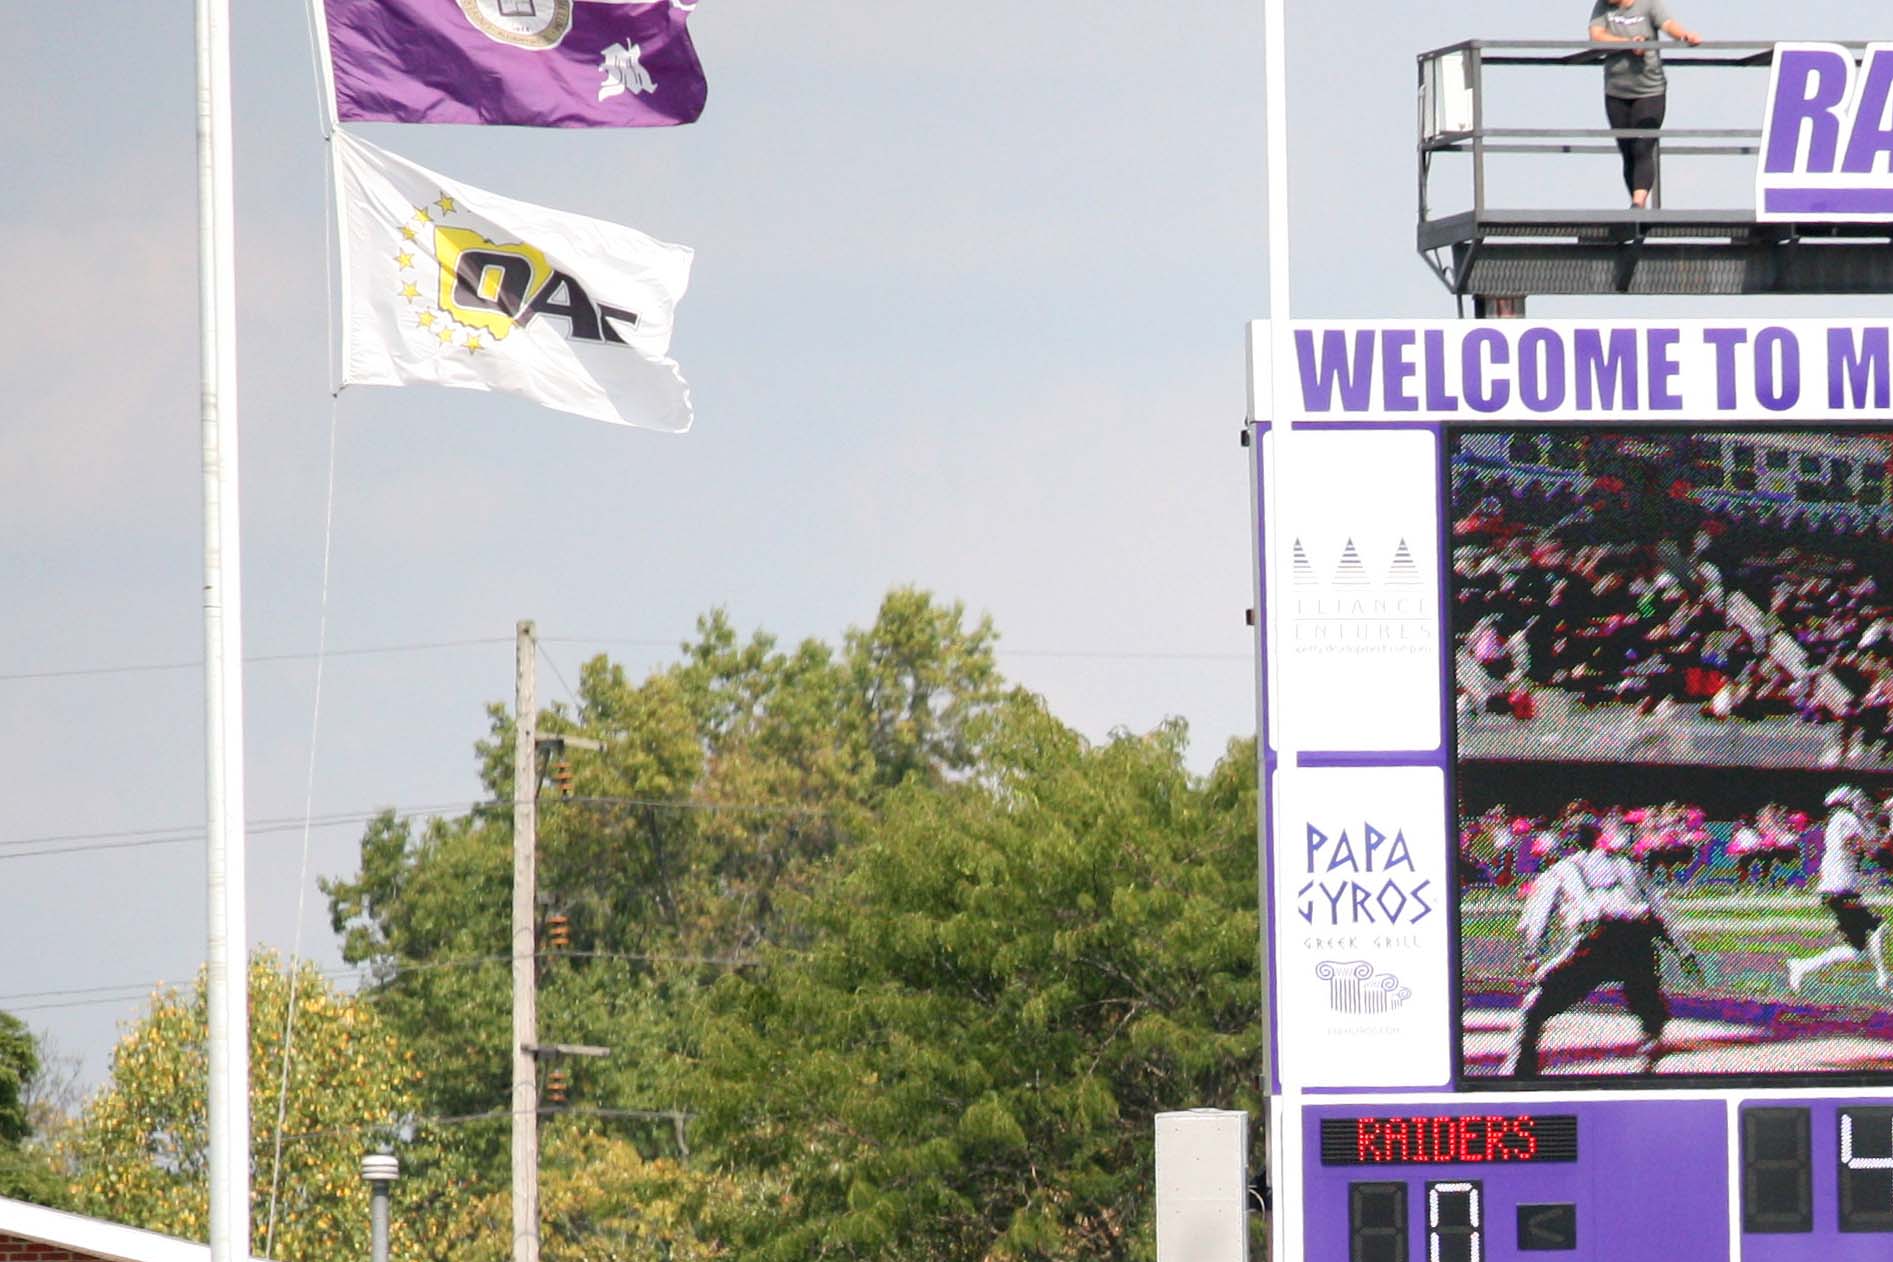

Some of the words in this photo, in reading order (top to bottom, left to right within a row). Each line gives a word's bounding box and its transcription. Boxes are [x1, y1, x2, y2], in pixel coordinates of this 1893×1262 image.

[1294, 327, 1682, 412] WELCOME
[1704, 326, 1801, 412] TO
[1306, 821, 1416, 873] PAPA
[1298, 878, 1433, 925] GYROS
[1356, 1114, 1537, 1161] RAIDERS
